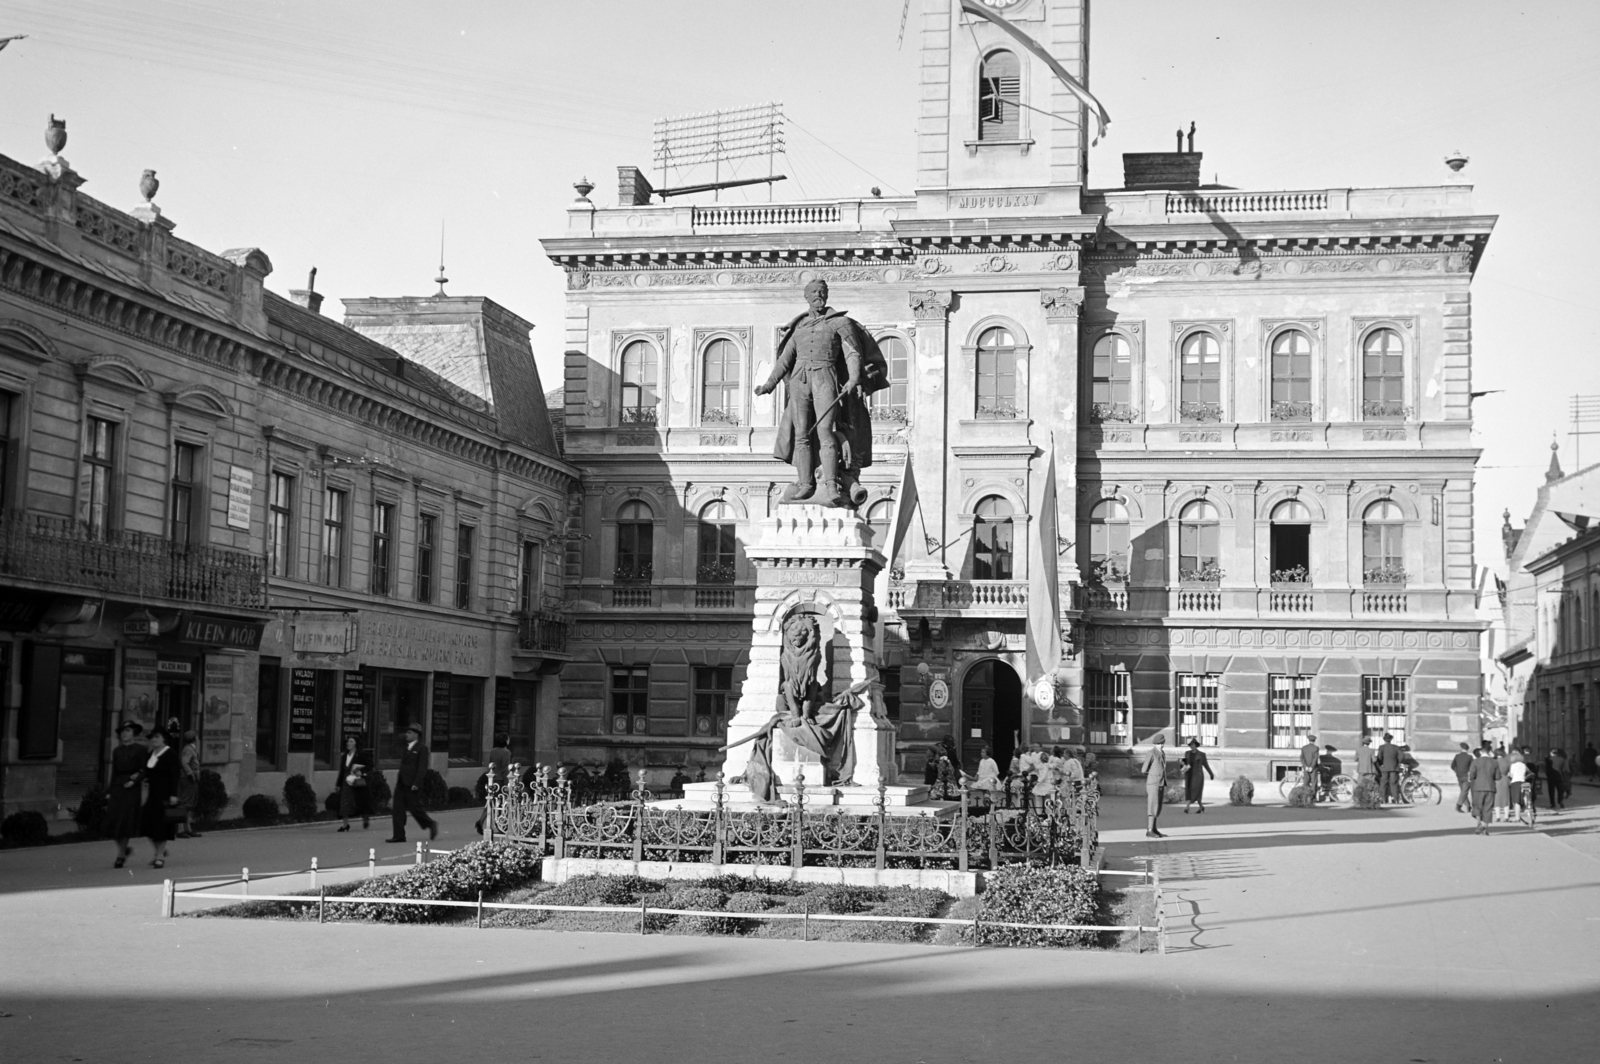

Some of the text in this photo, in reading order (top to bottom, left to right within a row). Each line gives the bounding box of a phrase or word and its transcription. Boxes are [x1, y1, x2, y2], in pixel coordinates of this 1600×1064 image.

[959, 195, 1039, 209] MDCCCLXXV
[788, 572, 830, 583] KLAPKA
[186, 621, 226, 641] KLEIN
[229, 625, 257, 645] MÓR
[296, 633, 323, 646] KLEIN
